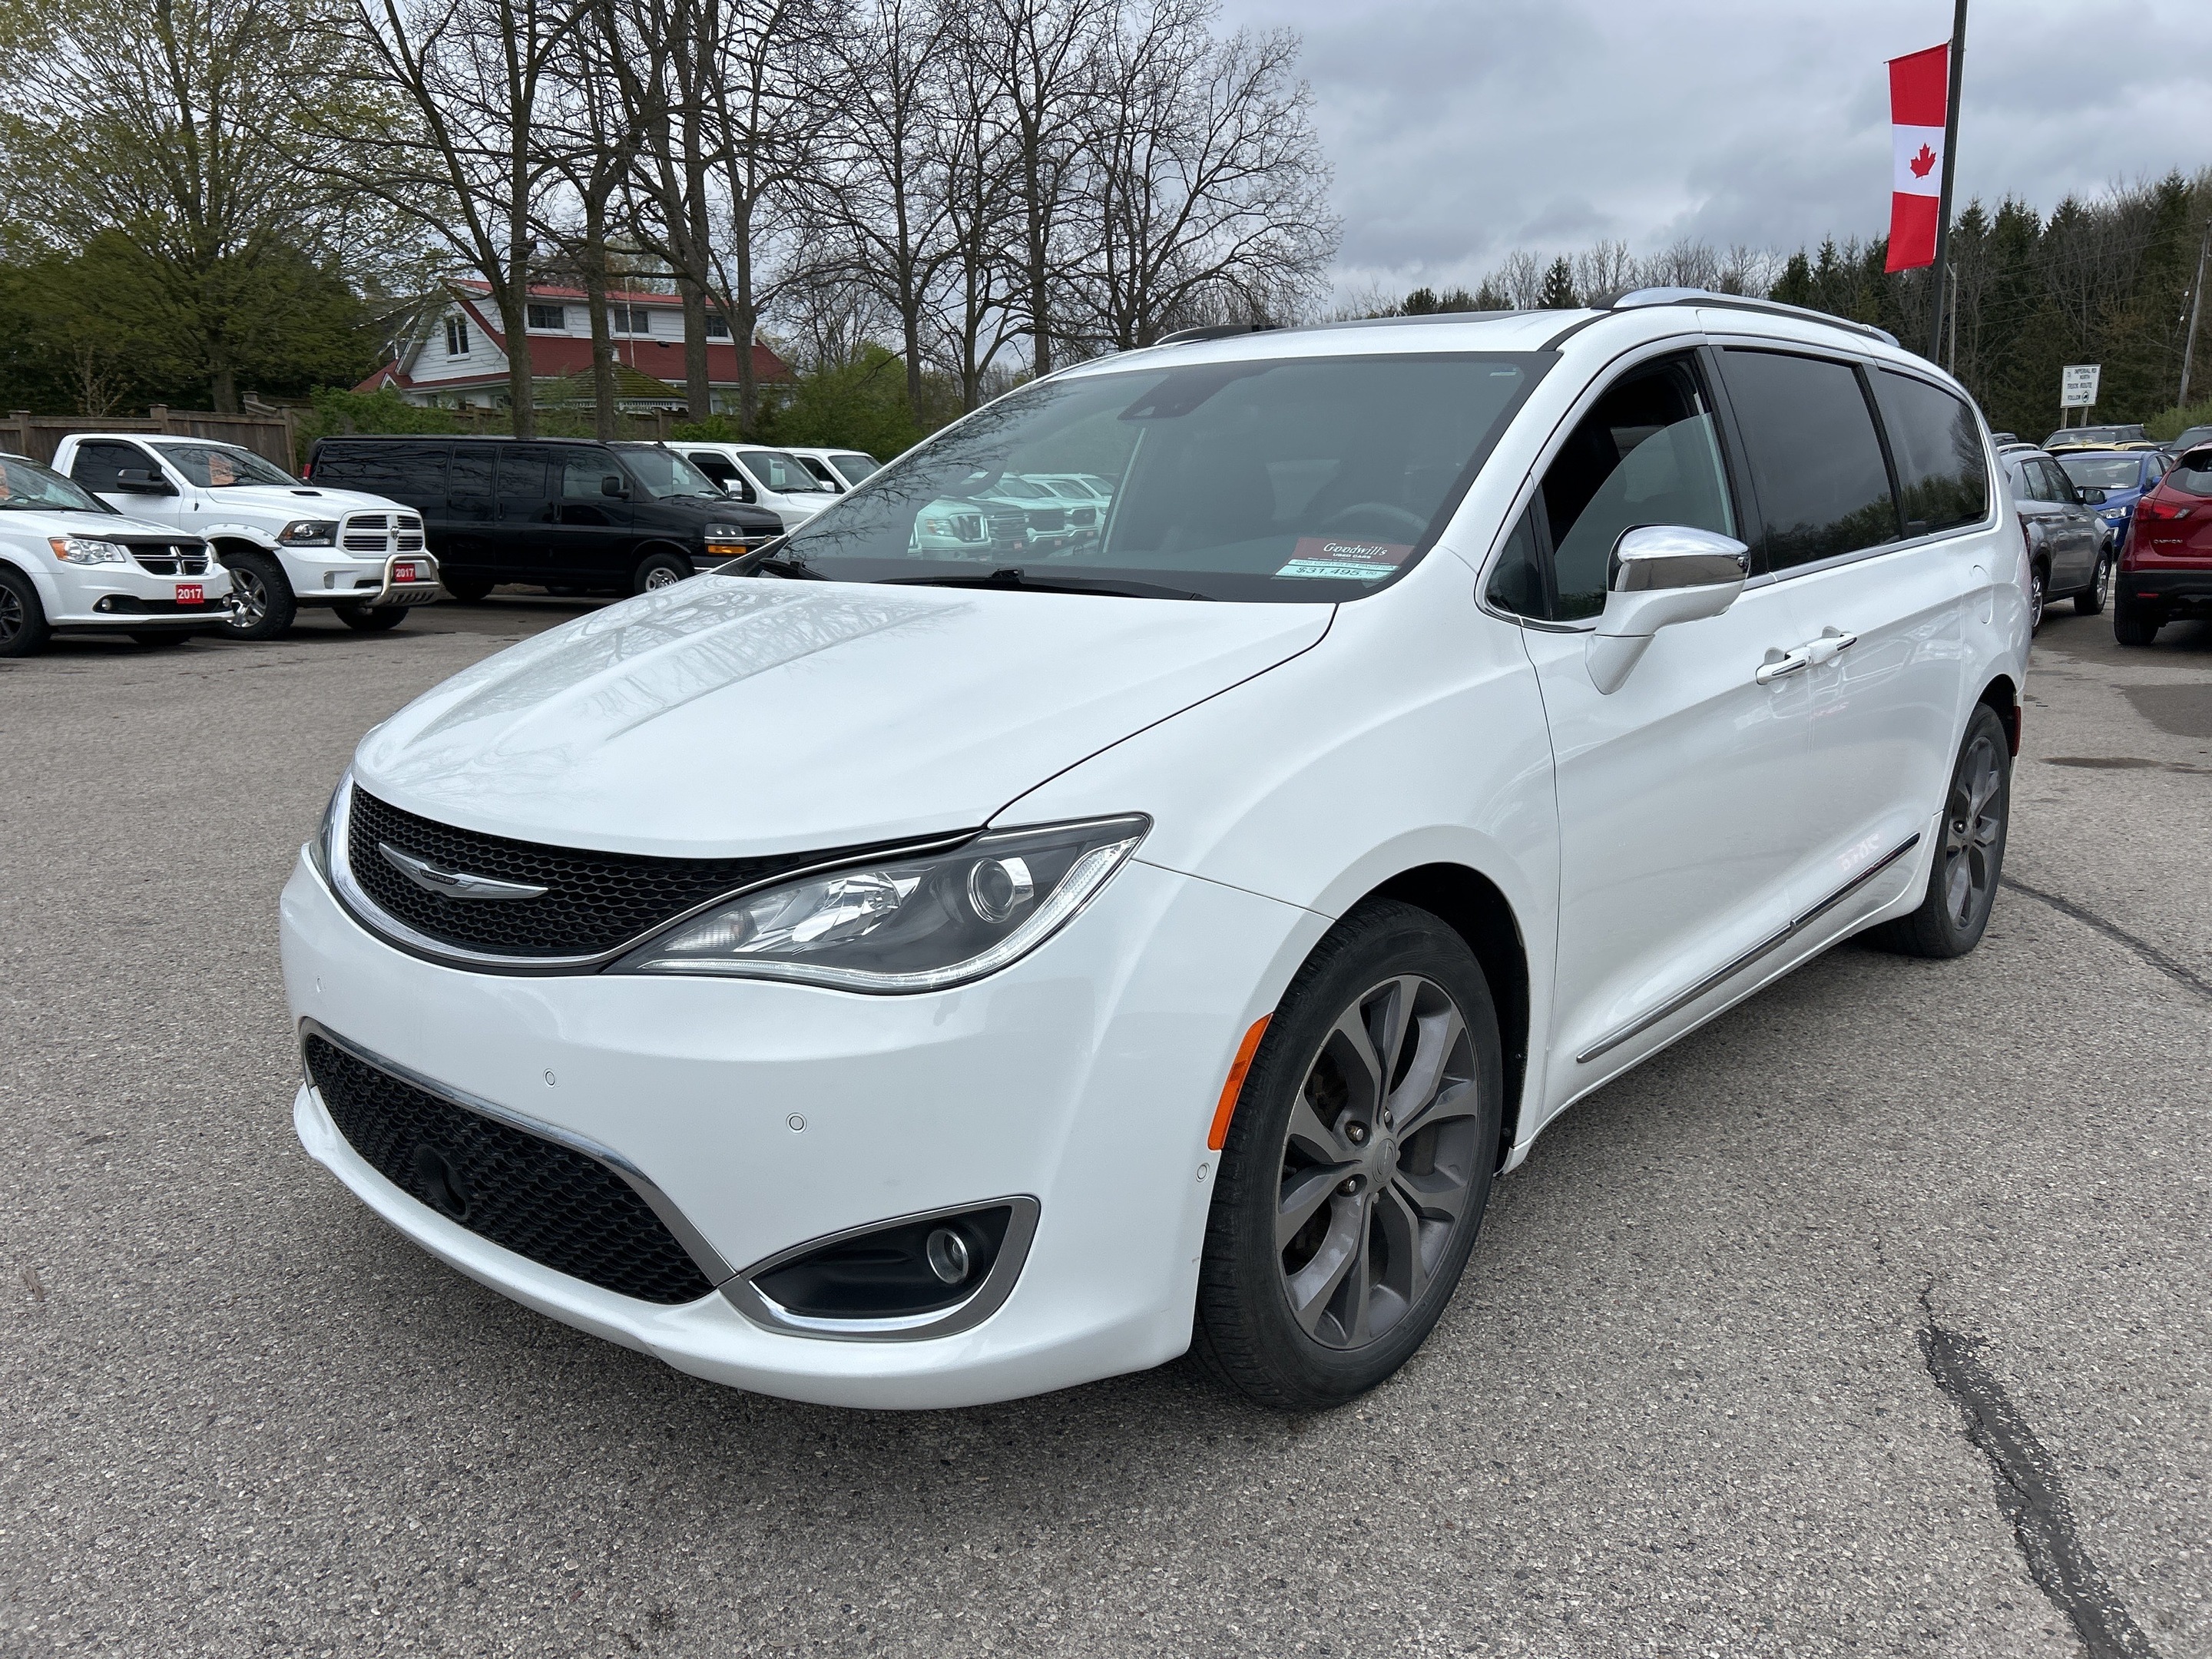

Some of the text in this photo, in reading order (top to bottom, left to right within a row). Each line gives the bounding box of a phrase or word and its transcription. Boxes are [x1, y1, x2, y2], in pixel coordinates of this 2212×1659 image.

[1323, 542, 1388, 556] Goodwill's
[396, 568, 414, 578] 2017
[177, 588, 202, 599] 2017
